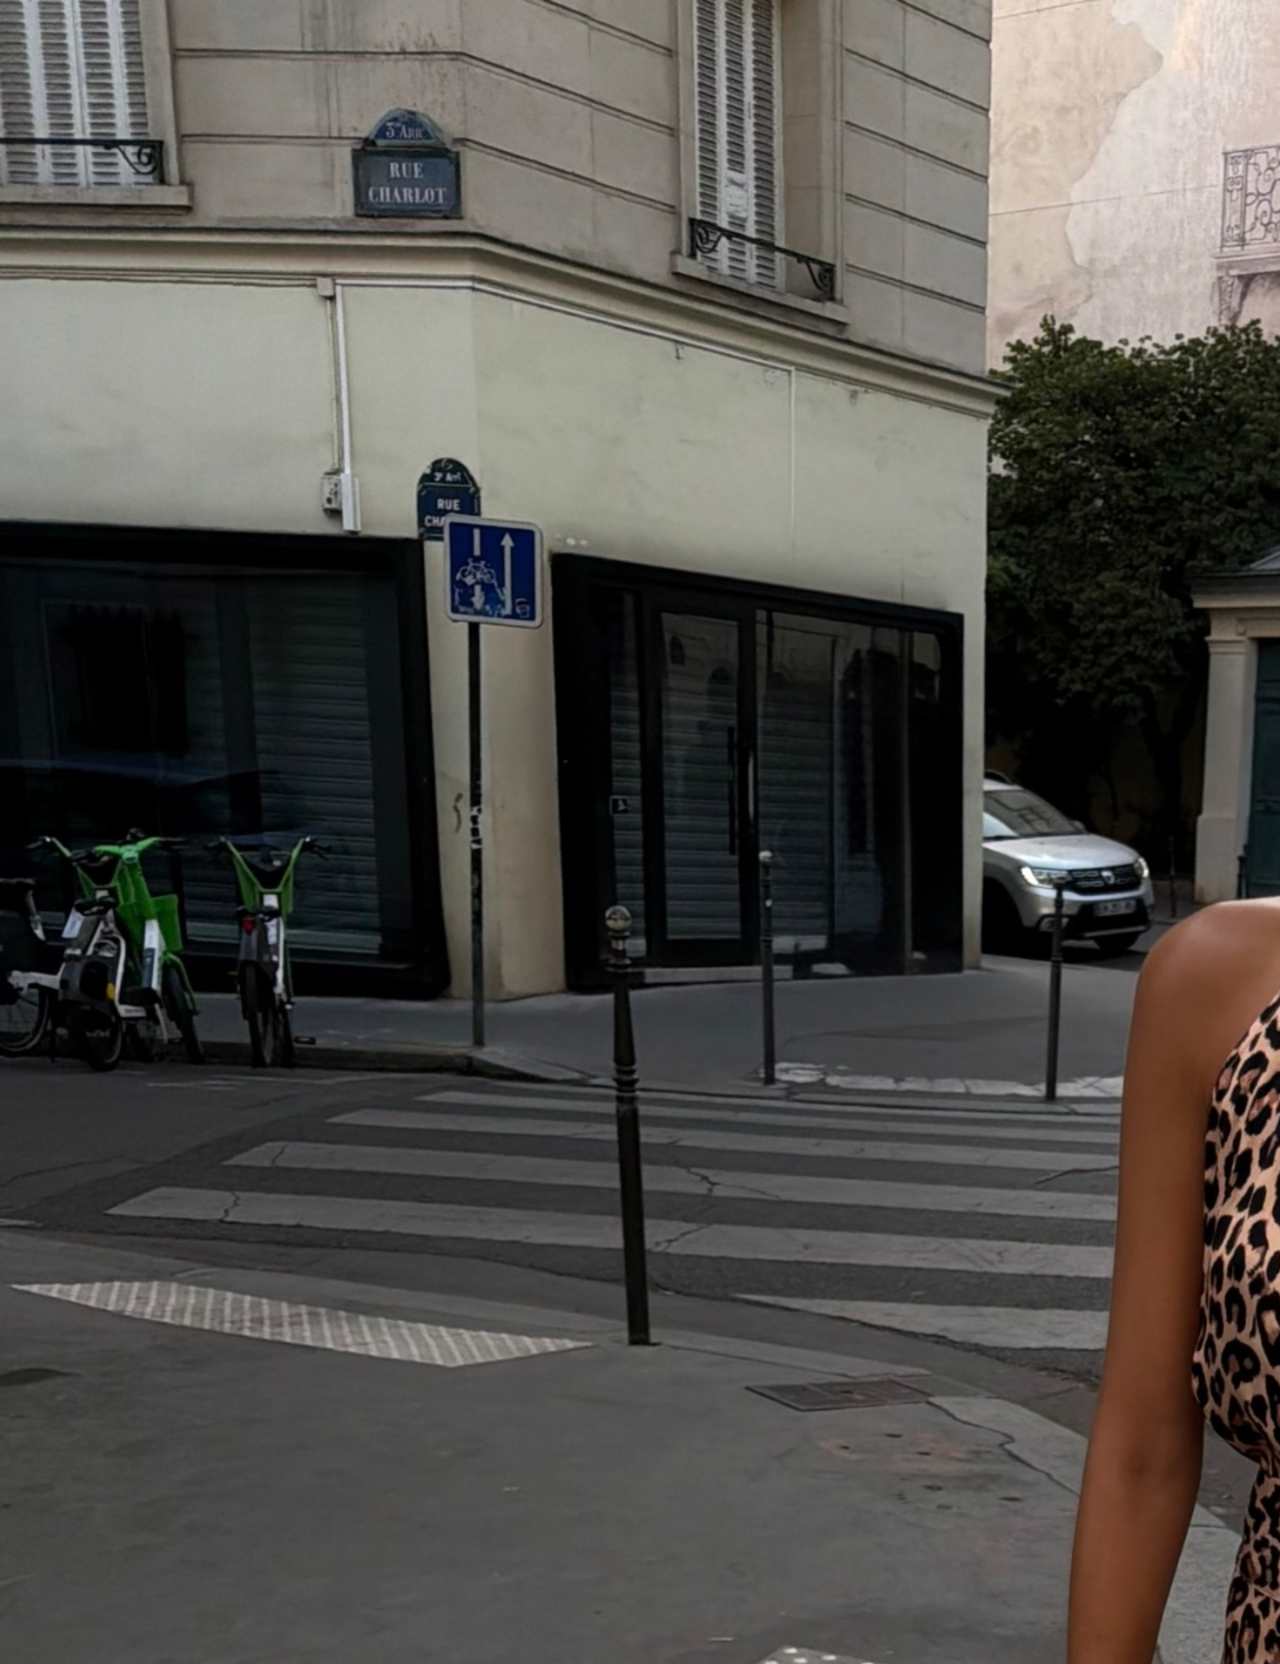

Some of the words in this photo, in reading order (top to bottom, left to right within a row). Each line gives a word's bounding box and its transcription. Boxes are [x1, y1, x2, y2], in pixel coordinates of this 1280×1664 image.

[389, 162, 424, 179] RUE
[368, 186, 447, 204] CHARLOT
[437, 498, 461, 511] RUE
